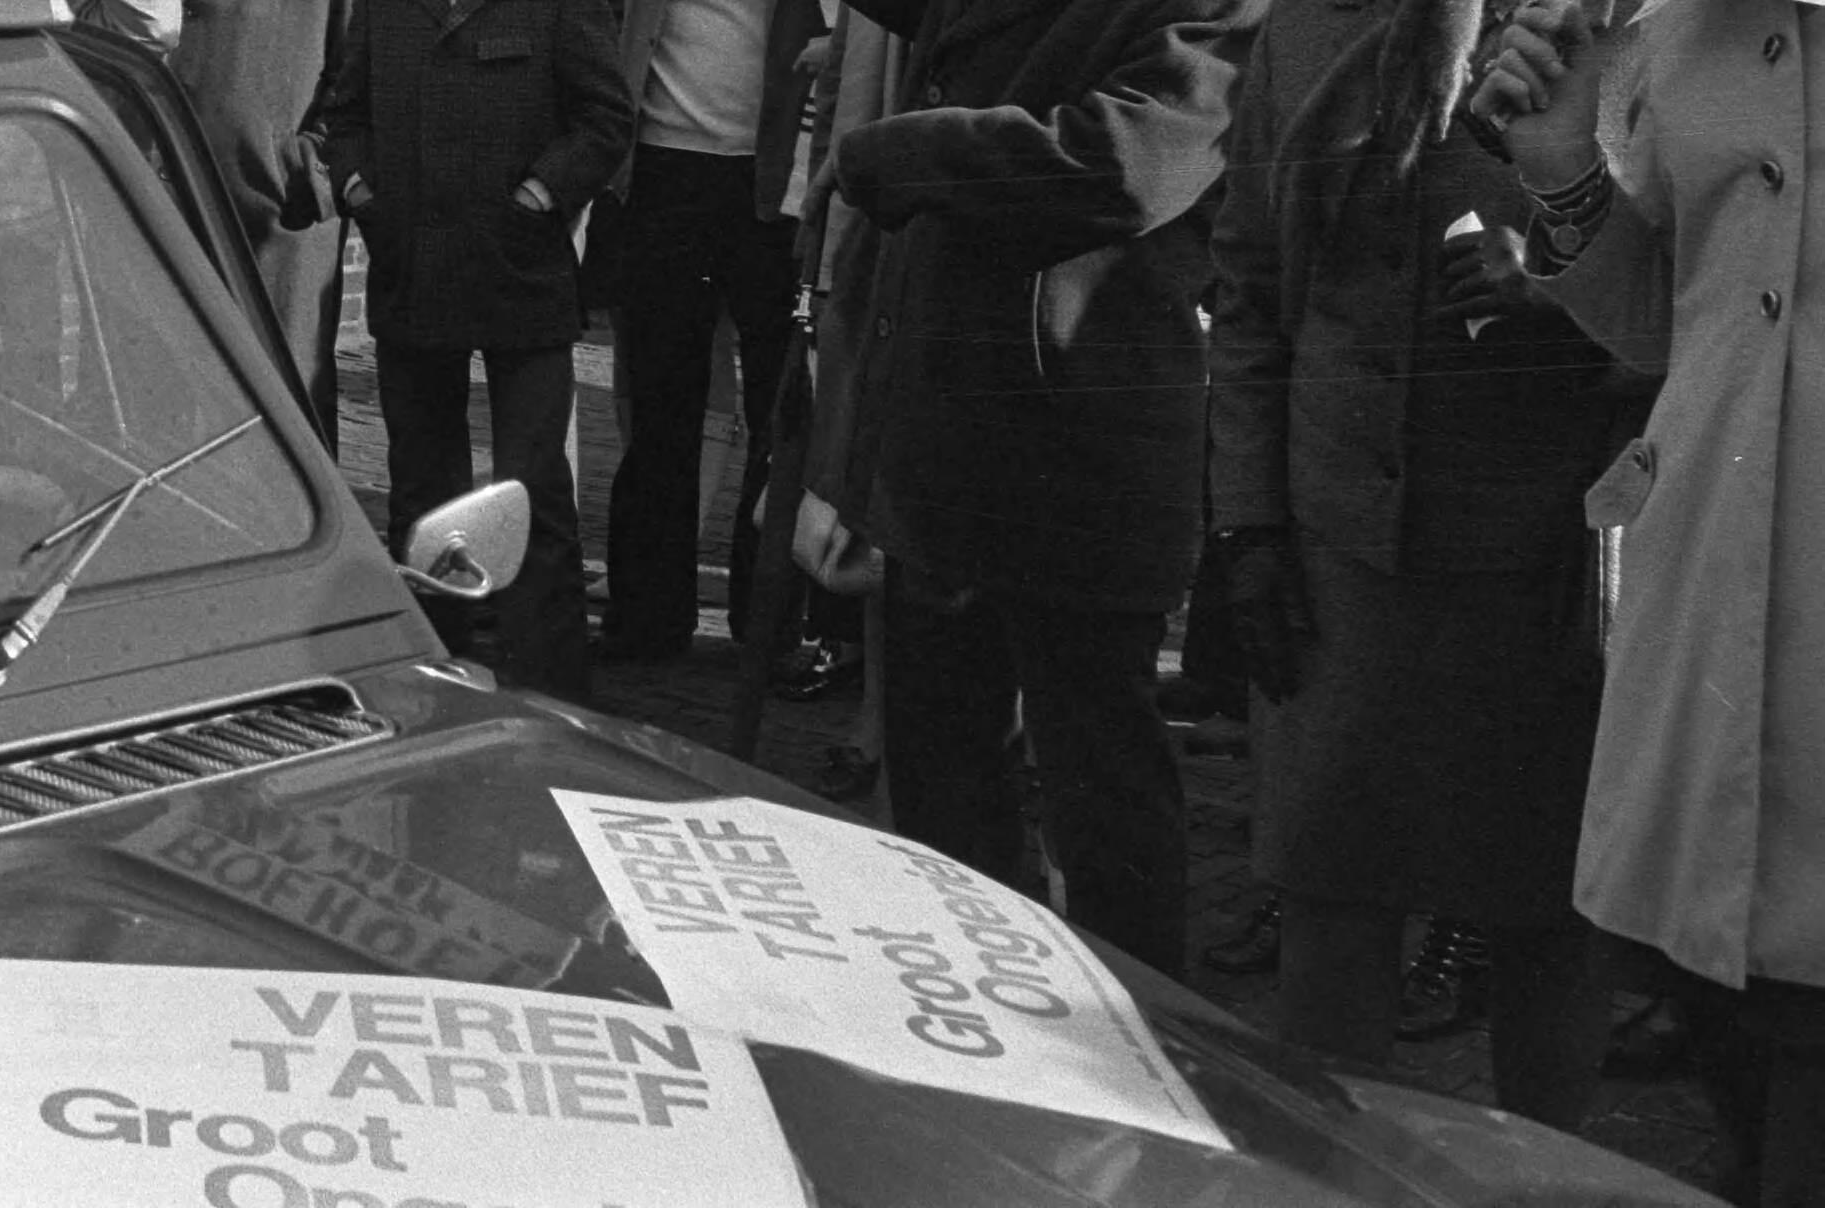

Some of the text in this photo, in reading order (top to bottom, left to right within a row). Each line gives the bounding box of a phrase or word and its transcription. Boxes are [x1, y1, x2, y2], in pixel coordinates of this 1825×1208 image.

[589, 806, 739, 935] VEREN
[683, 817, 850, 964] TARIEF
[254, 988, 702, 1072] VEREN
[852, 925, 1006, 1060] Groot
[39, 1088, 409, 1173] Groot
[231, 1040, 710, 1128] TARIEF
